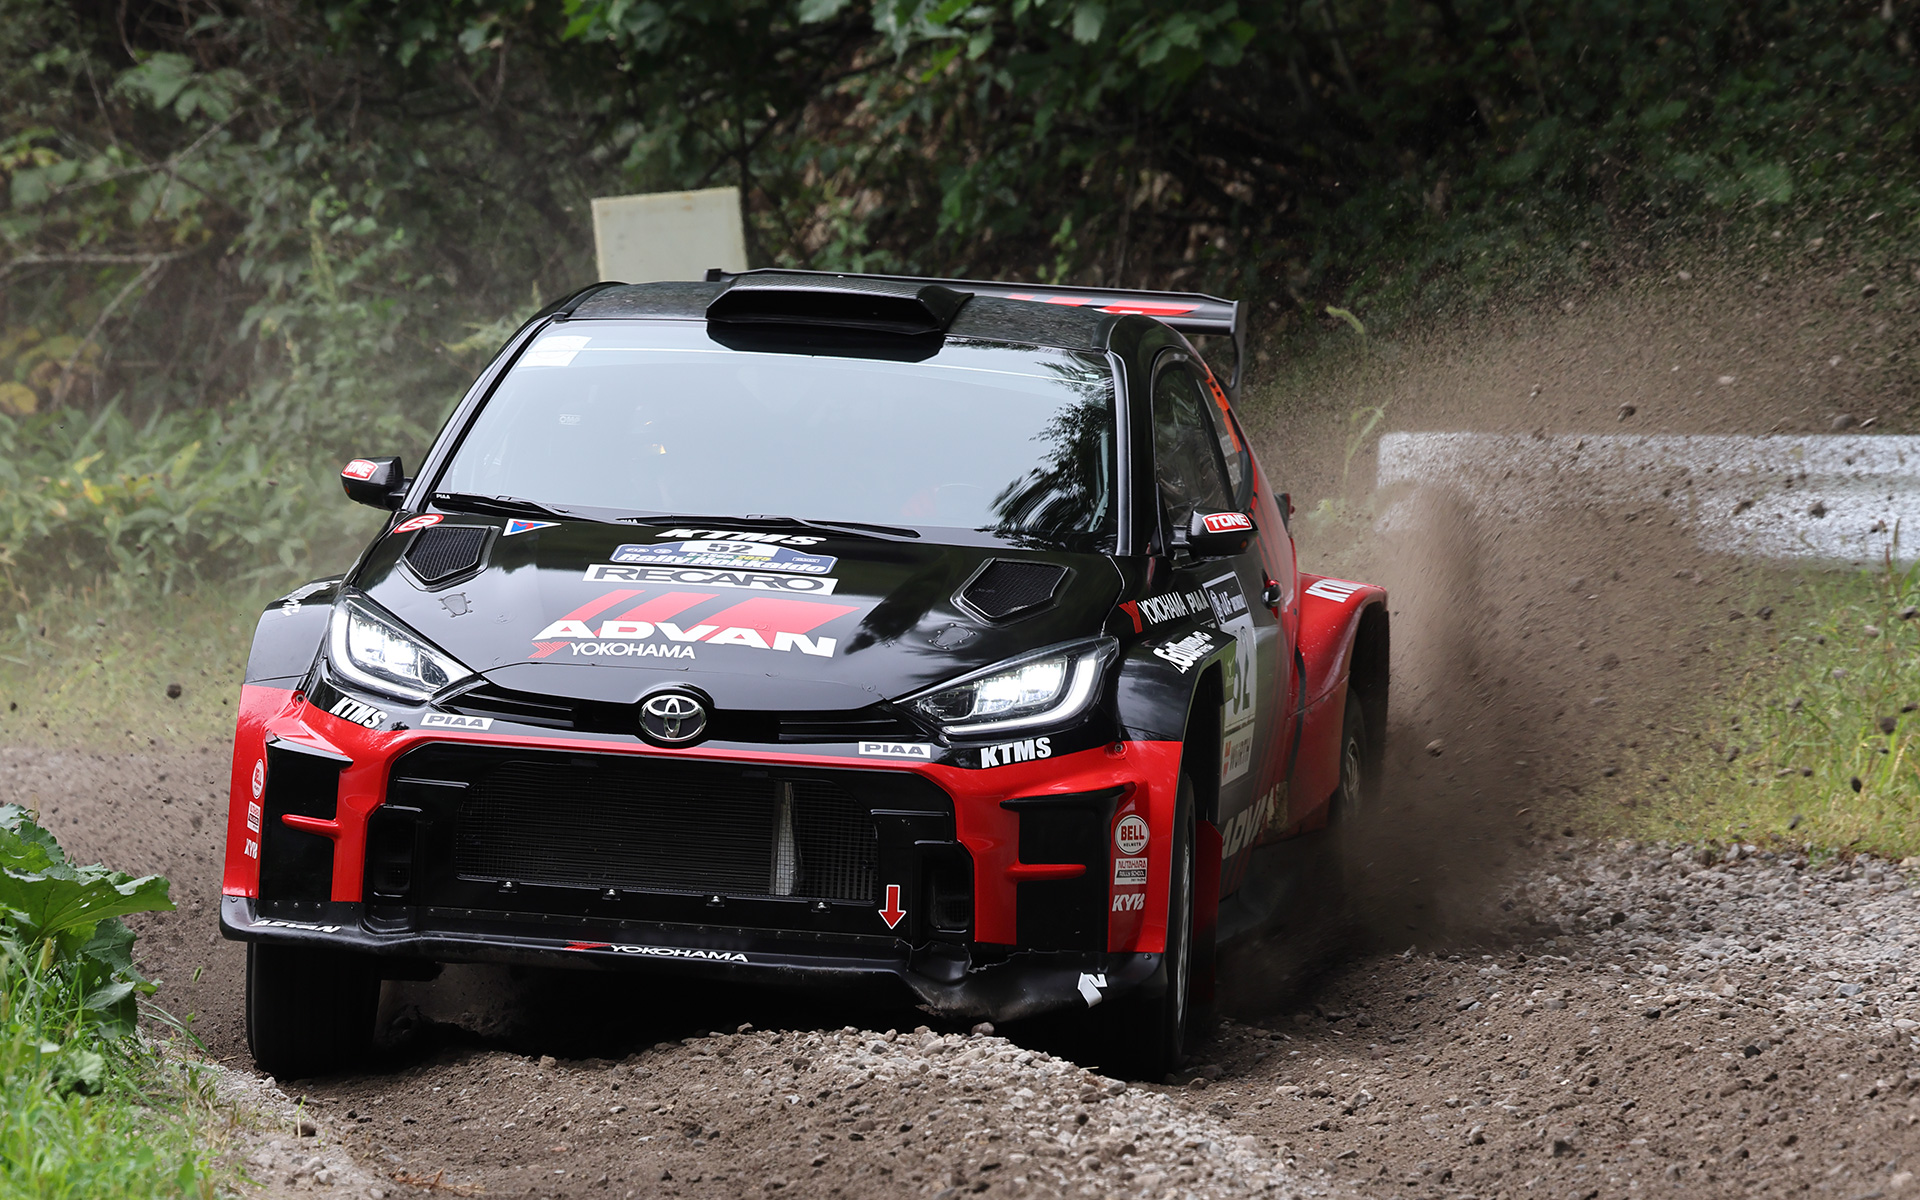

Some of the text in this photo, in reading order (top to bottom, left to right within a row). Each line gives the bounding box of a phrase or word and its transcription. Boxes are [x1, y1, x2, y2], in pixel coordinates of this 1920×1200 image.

[1207, 513, 1249, 530] TONE
[655, 528, 827, 546] KTMS
[706, 542, 753, 554] 52
[615, 552, 692, 566] Rally
[690, 556, 828, 574] Hokkaido
[593, 565, 825, 592] RECARO
[1136, 591, 1190, 625] YOKOHAMA
[1184, 589, 1211, 615] PIAA
[531, 619, 837, 658] ADVAN
[570, 641, 696, 660] YOKOHAMA
[328, 695, 389, 729] KTMS
[427, 715, 485, 728] PIAA
[864, 743, 926, 757] PIAA
[980, 737, 1053, 770] KTMS
[1120, 824, 1145, 842] BELL
[1111, 892, 1146, 912] KYB
[250, 919, 342, 934] ADVAN
[610, 944, 749, 963] YOKOHAMA
